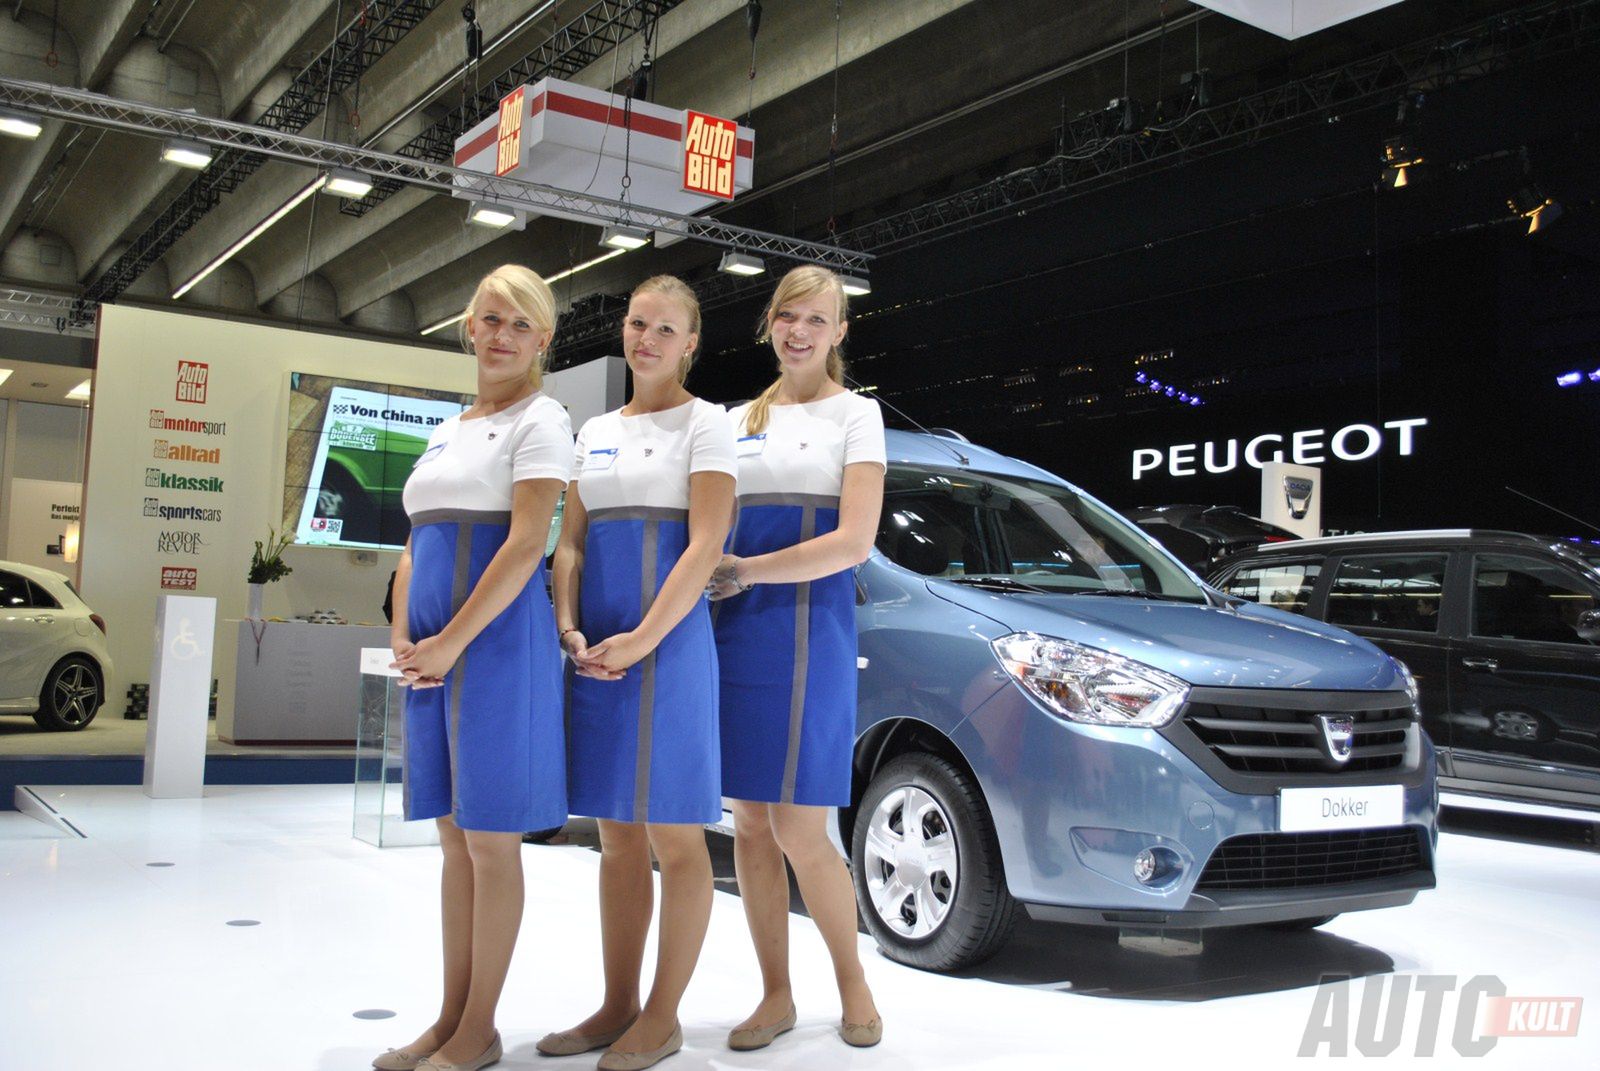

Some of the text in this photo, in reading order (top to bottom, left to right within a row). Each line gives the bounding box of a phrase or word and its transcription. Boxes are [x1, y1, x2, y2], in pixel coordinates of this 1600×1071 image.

[500, 95, 524, 140] Auto
[686, 116, 735, 162] Auto
[498, 129, 520, 175] Bild
[687, 153, 732, 195] Bild
[178, 363, 207, 384] Auto
[178, 382, 206, 402] Bild
[350, 404, 378, 418] Von
[381, 409, 424, 425] China
[168, 445, 220, 464] allrad
[1132, 418, 1427, 480] PEUGEOT
[160, 472, 224, 493] klassik
[51, 504, 80, 513] Perfekt
[157, 540, 201, 555] REVUE
[159, 531, 204, 545] MOTOR
[163, 569, 196, 579] auto
[163, 578, 195, 586] TEST
[1322, 797, 1369, 818] Dokker
